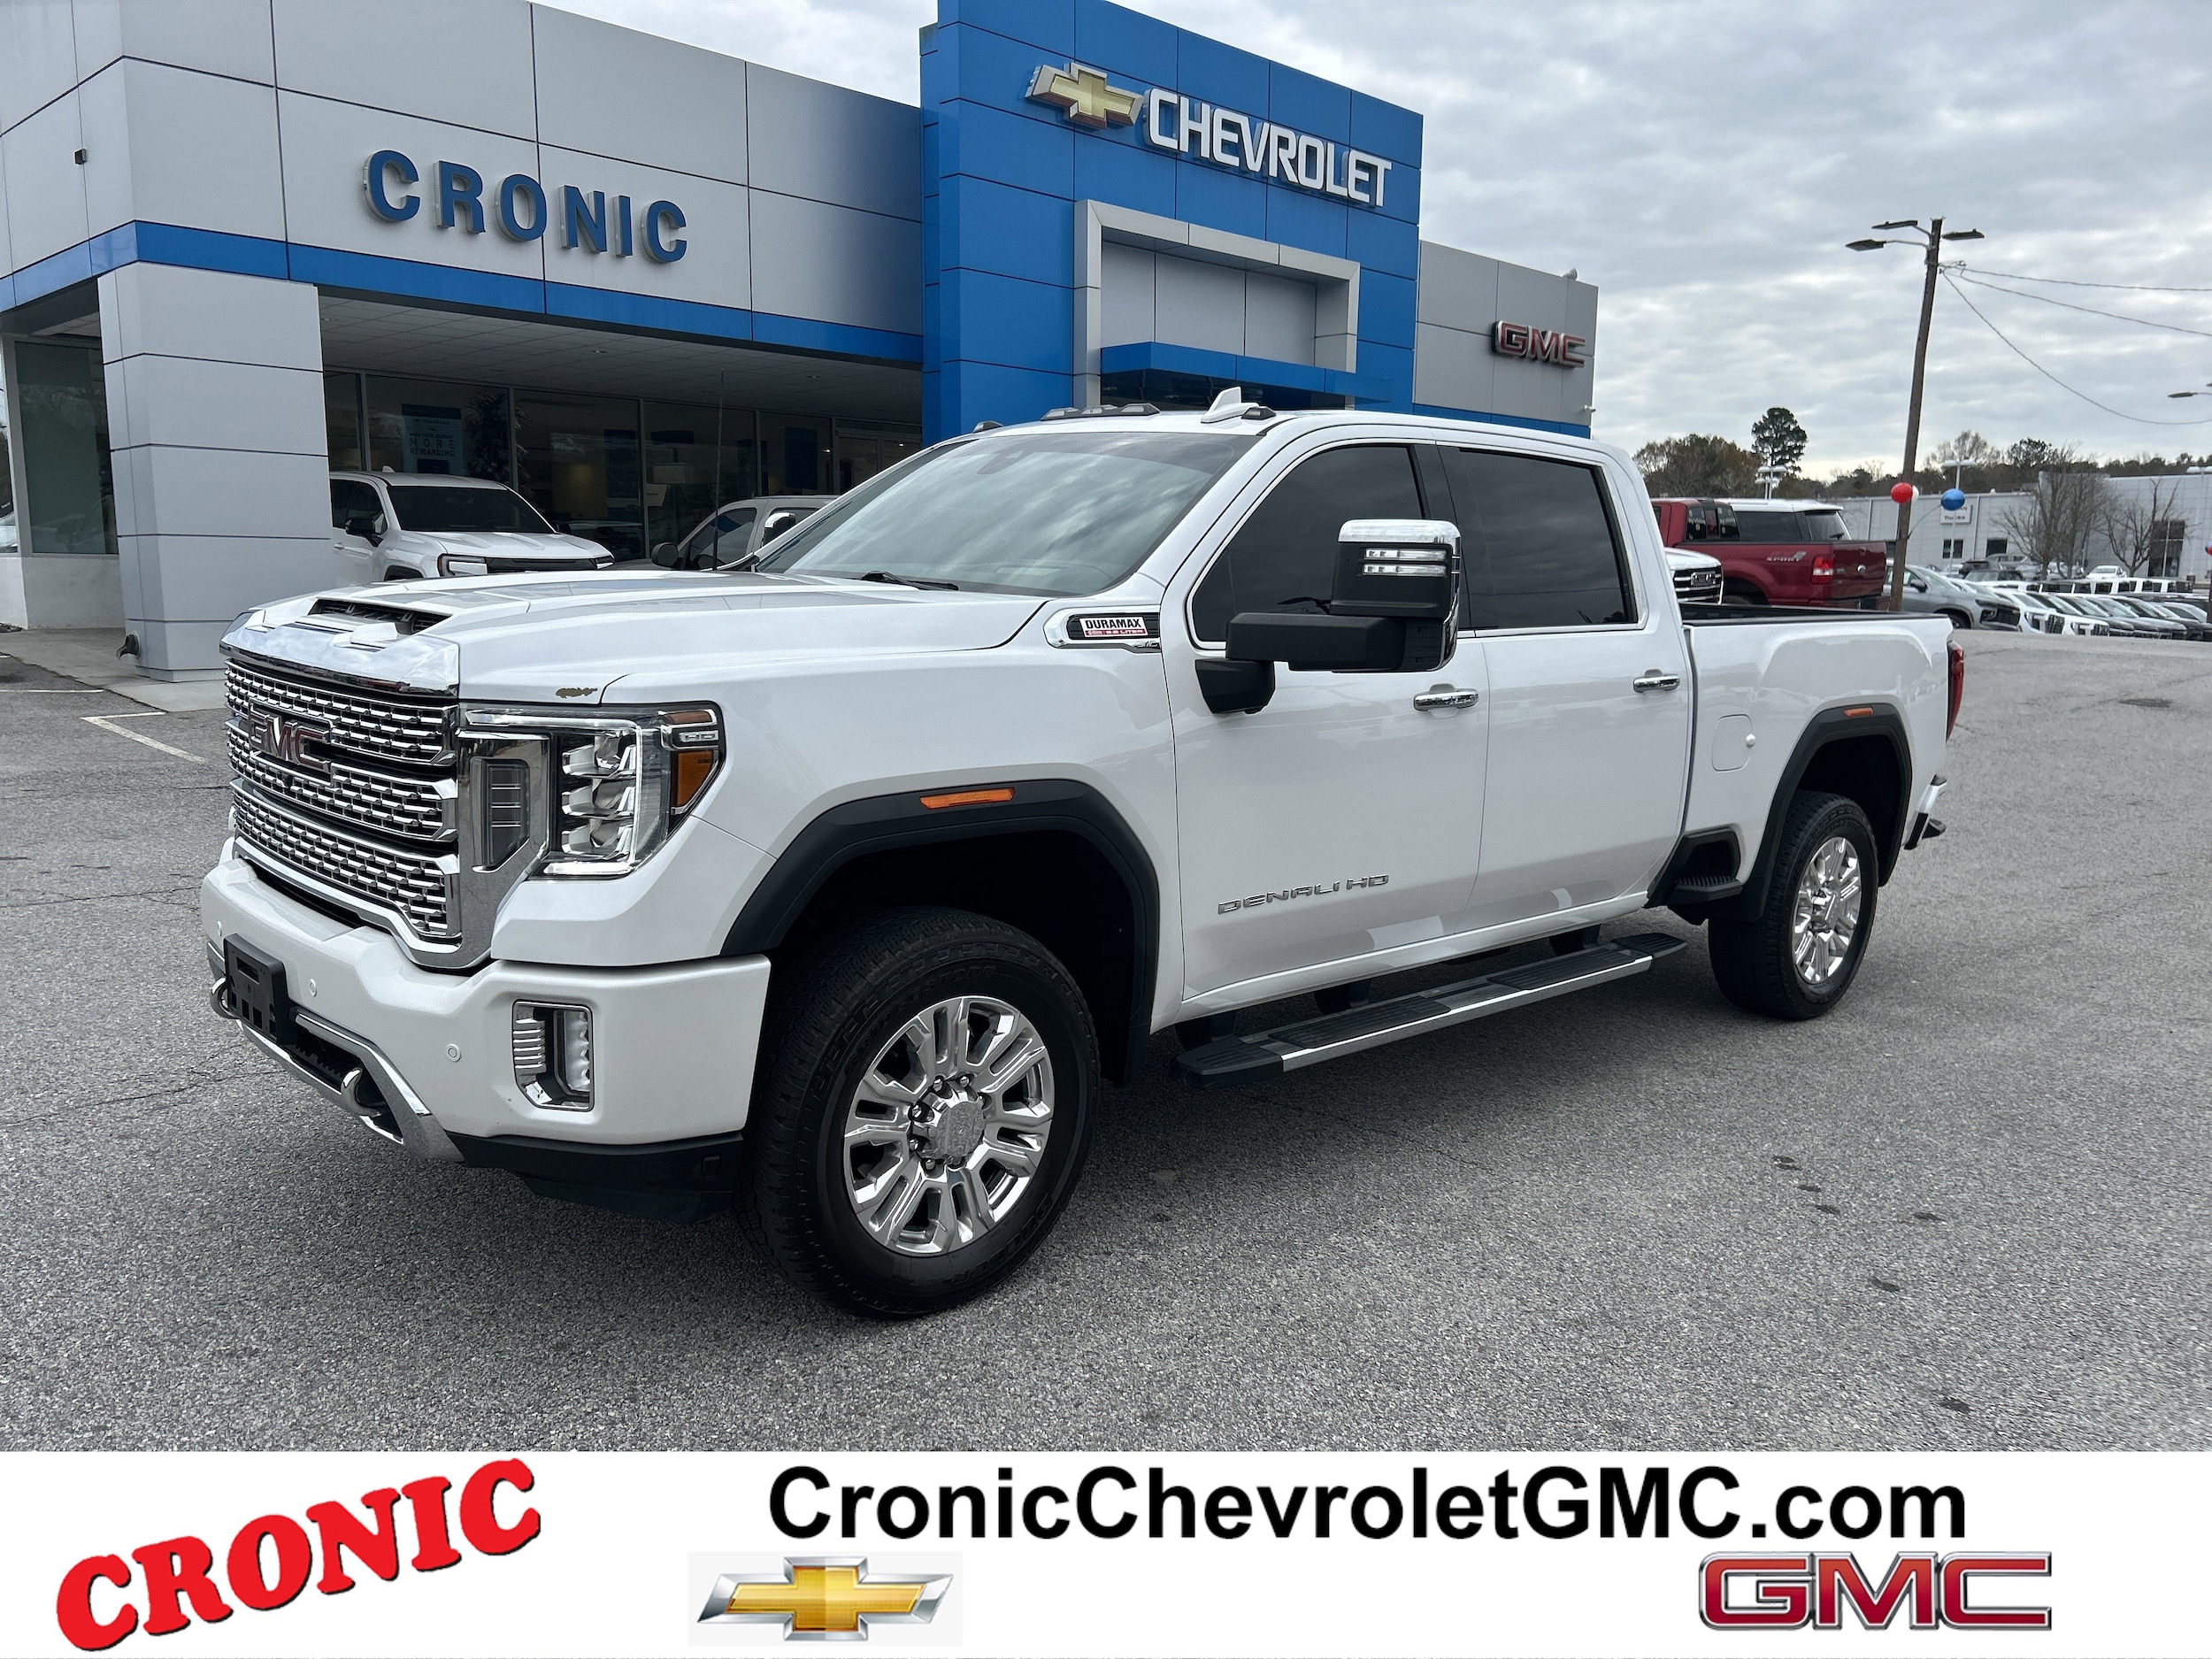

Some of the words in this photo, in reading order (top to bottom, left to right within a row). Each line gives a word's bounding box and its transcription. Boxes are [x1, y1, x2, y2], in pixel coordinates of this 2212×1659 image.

[1143, 88, 1392, 207] CHEVROLET
[364, 149, 688, 264] CRONIC
[1492, 319, 1586, 368] GMC
[409, 448, 455, 457] REWARDING
[1085, 618, 1142, 629] DURAMAX
[248, 703, 332, 774] GMC
[679, 730, 718, 742] HD
[1217, 880, 1340, 915] DENALI
[1346, 873, 1390, 890] HD
